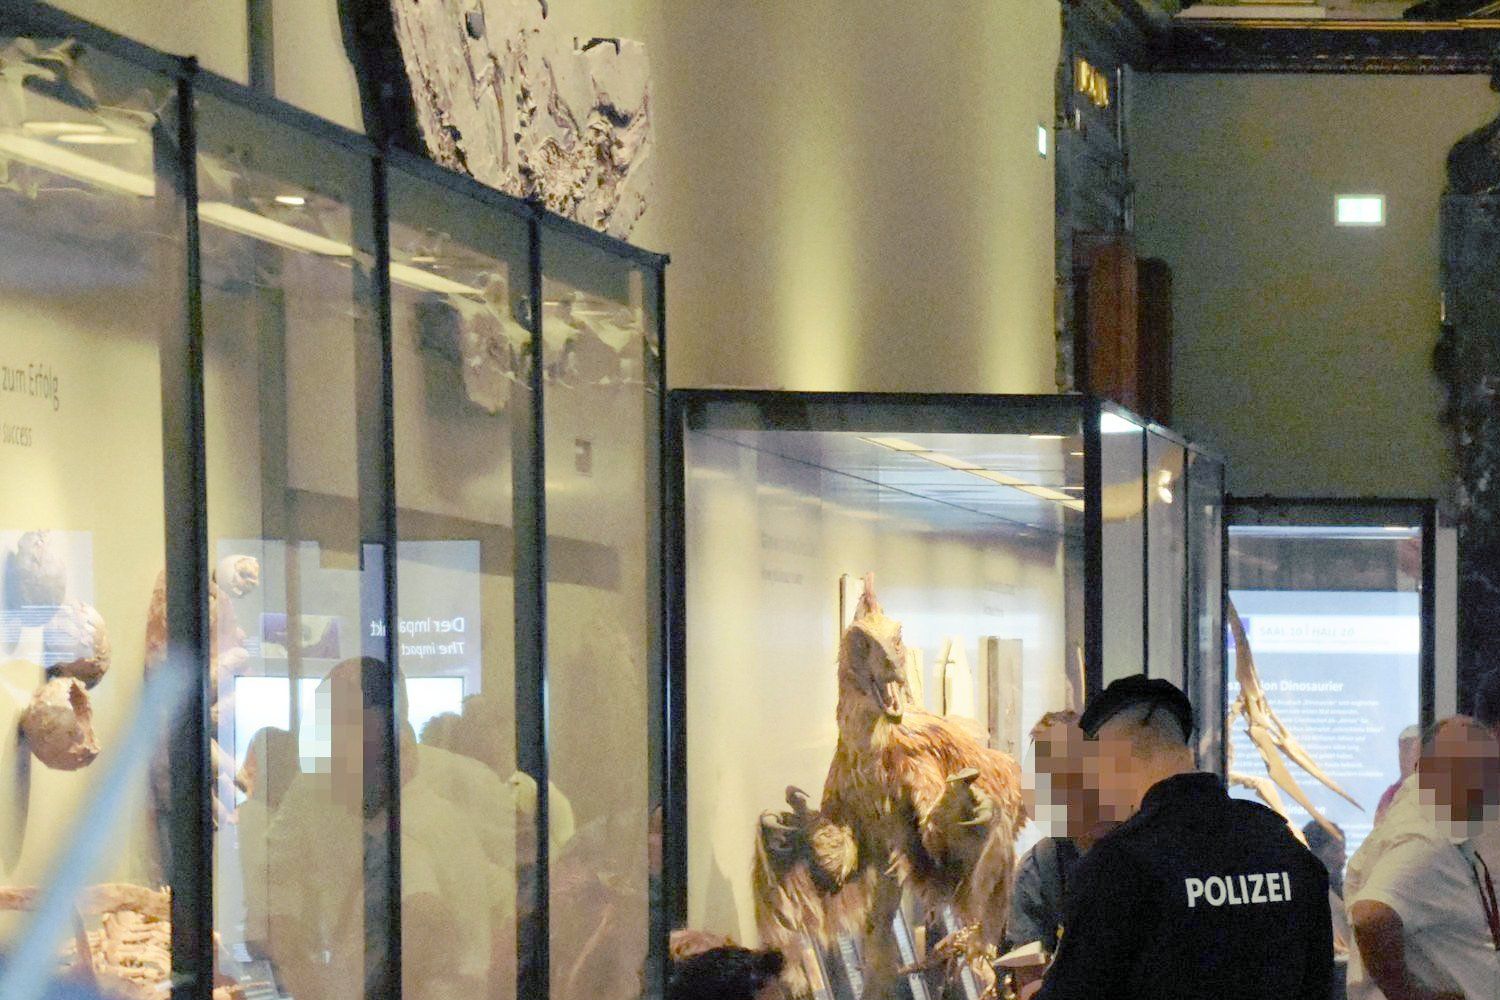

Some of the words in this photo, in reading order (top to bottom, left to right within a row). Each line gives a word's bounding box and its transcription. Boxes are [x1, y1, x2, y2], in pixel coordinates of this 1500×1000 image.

[2, 366, 26, 392] zum
[28, 363, 59, 411] Erfolg
[1280, 679, 1344, 692] Dinosaurier
[1185, 871, 1292, 907] POLIZEI
